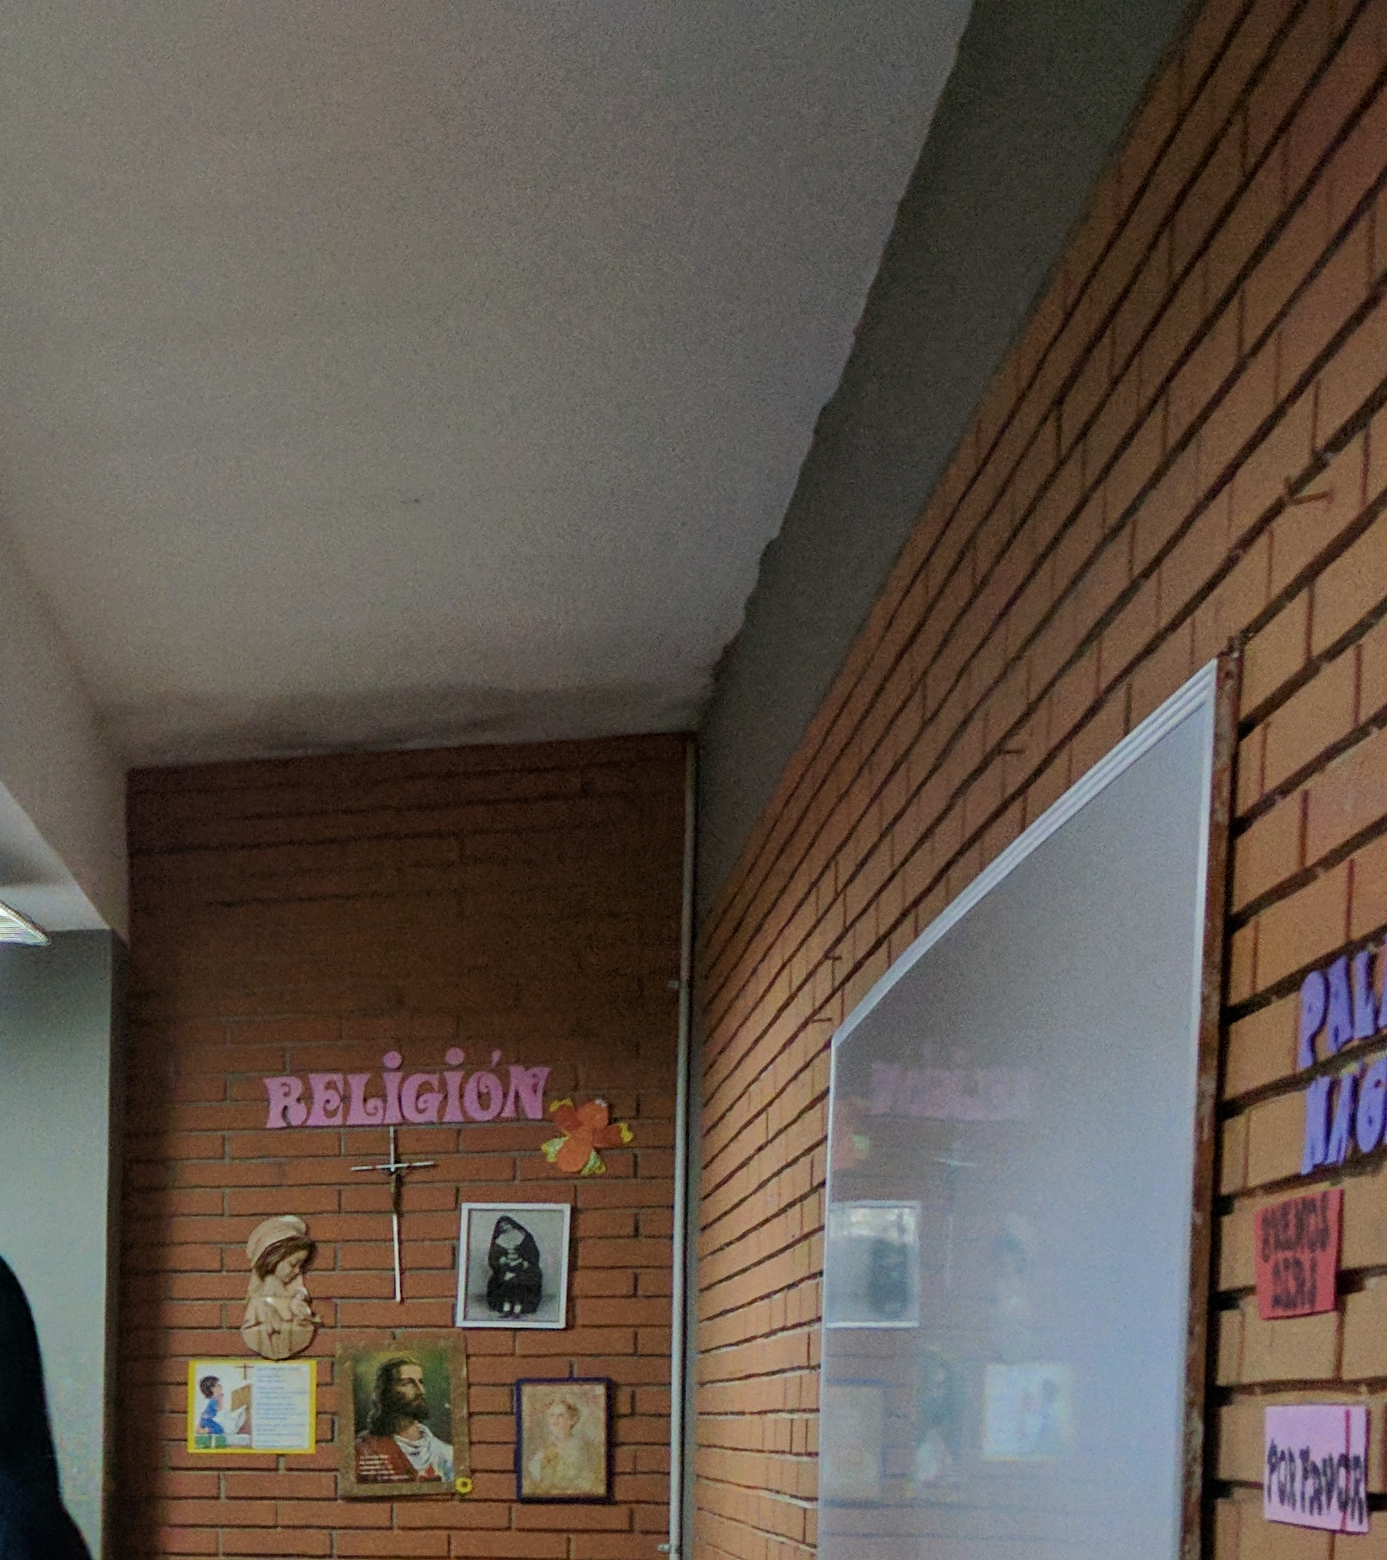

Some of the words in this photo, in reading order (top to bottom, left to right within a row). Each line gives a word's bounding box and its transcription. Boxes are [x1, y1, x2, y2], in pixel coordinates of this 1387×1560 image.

[1298, 940, 1387, 1068] PAL
[1267, 1438, 1297, 1511] POR
[1298, 1445, 1364, 1526] FAVOR
